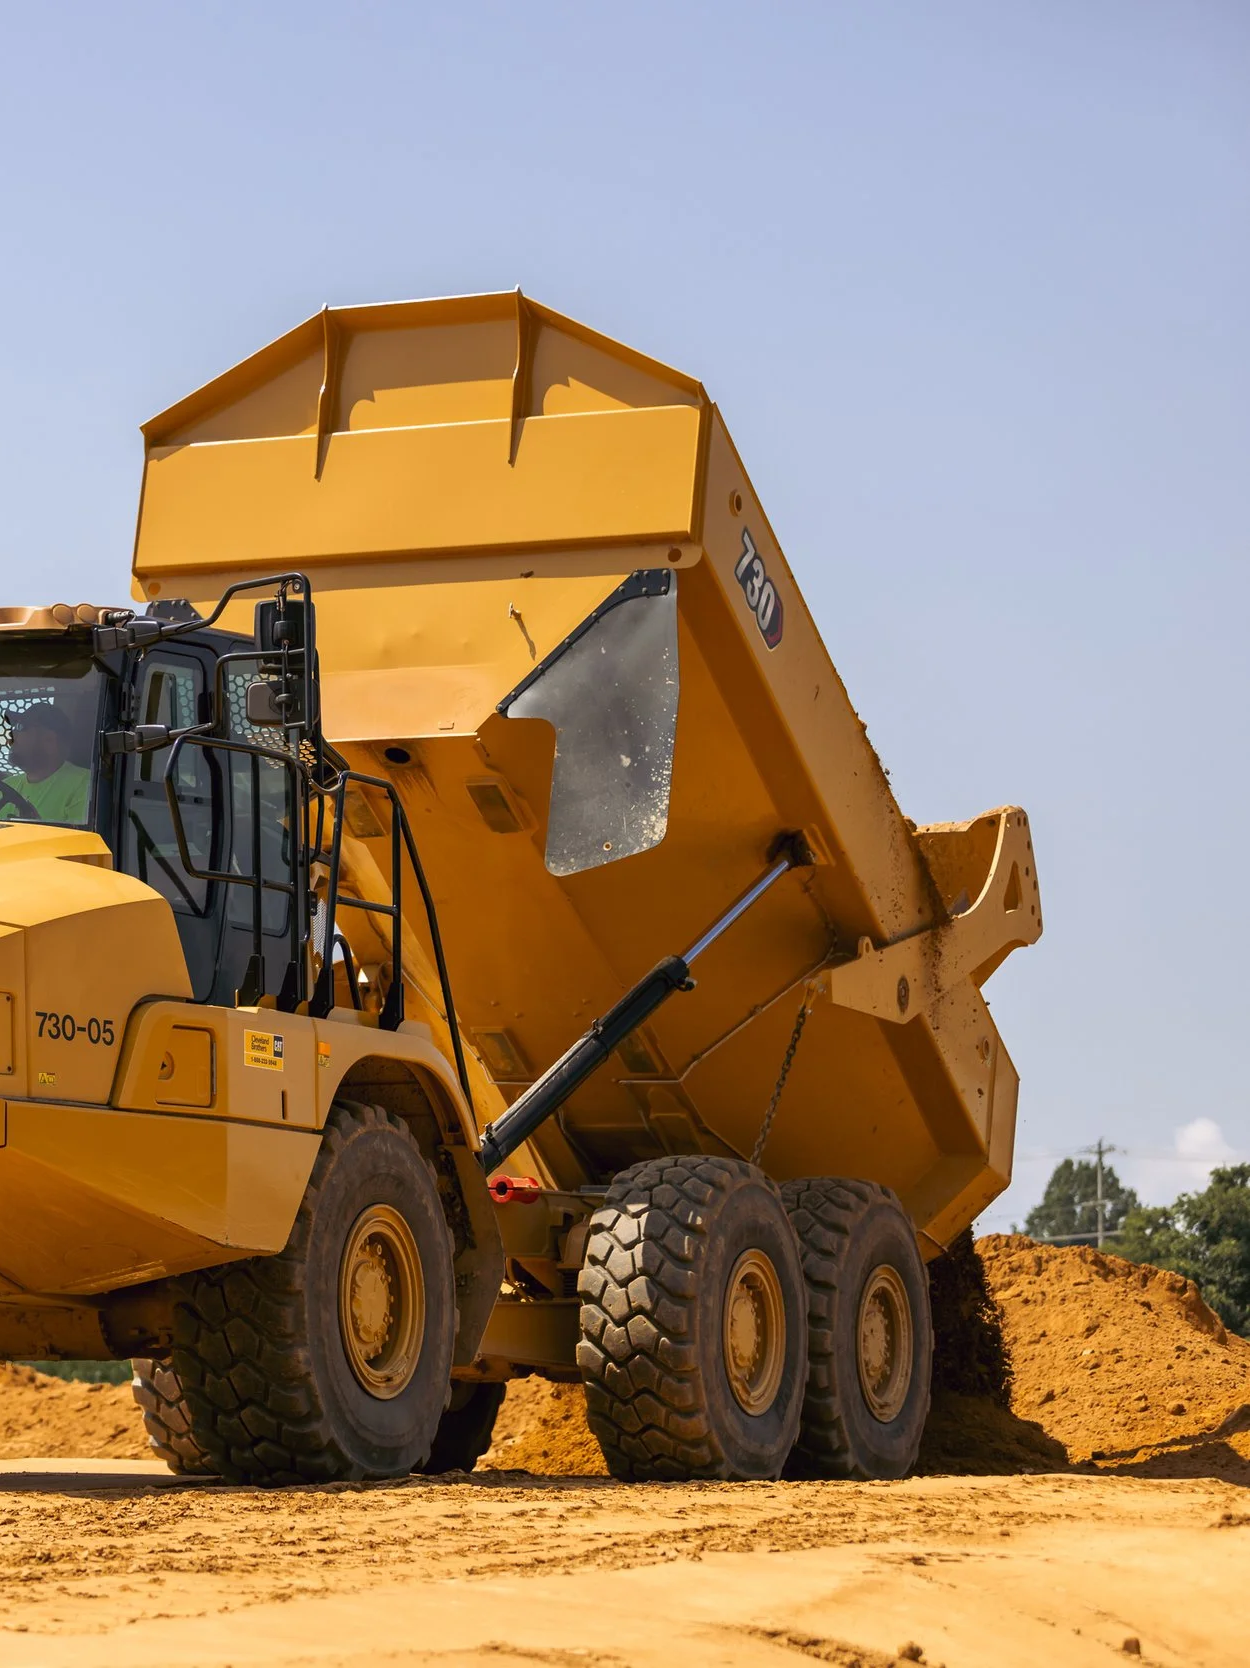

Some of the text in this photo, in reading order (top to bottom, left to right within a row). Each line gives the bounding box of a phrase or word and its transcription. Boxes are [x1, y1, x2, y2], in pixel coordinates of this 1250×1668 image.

[734, 530, 776, 631] 730
[35, 1011, 115, 1046] 730-05
[274, 1040, 282, 1052] CAT
